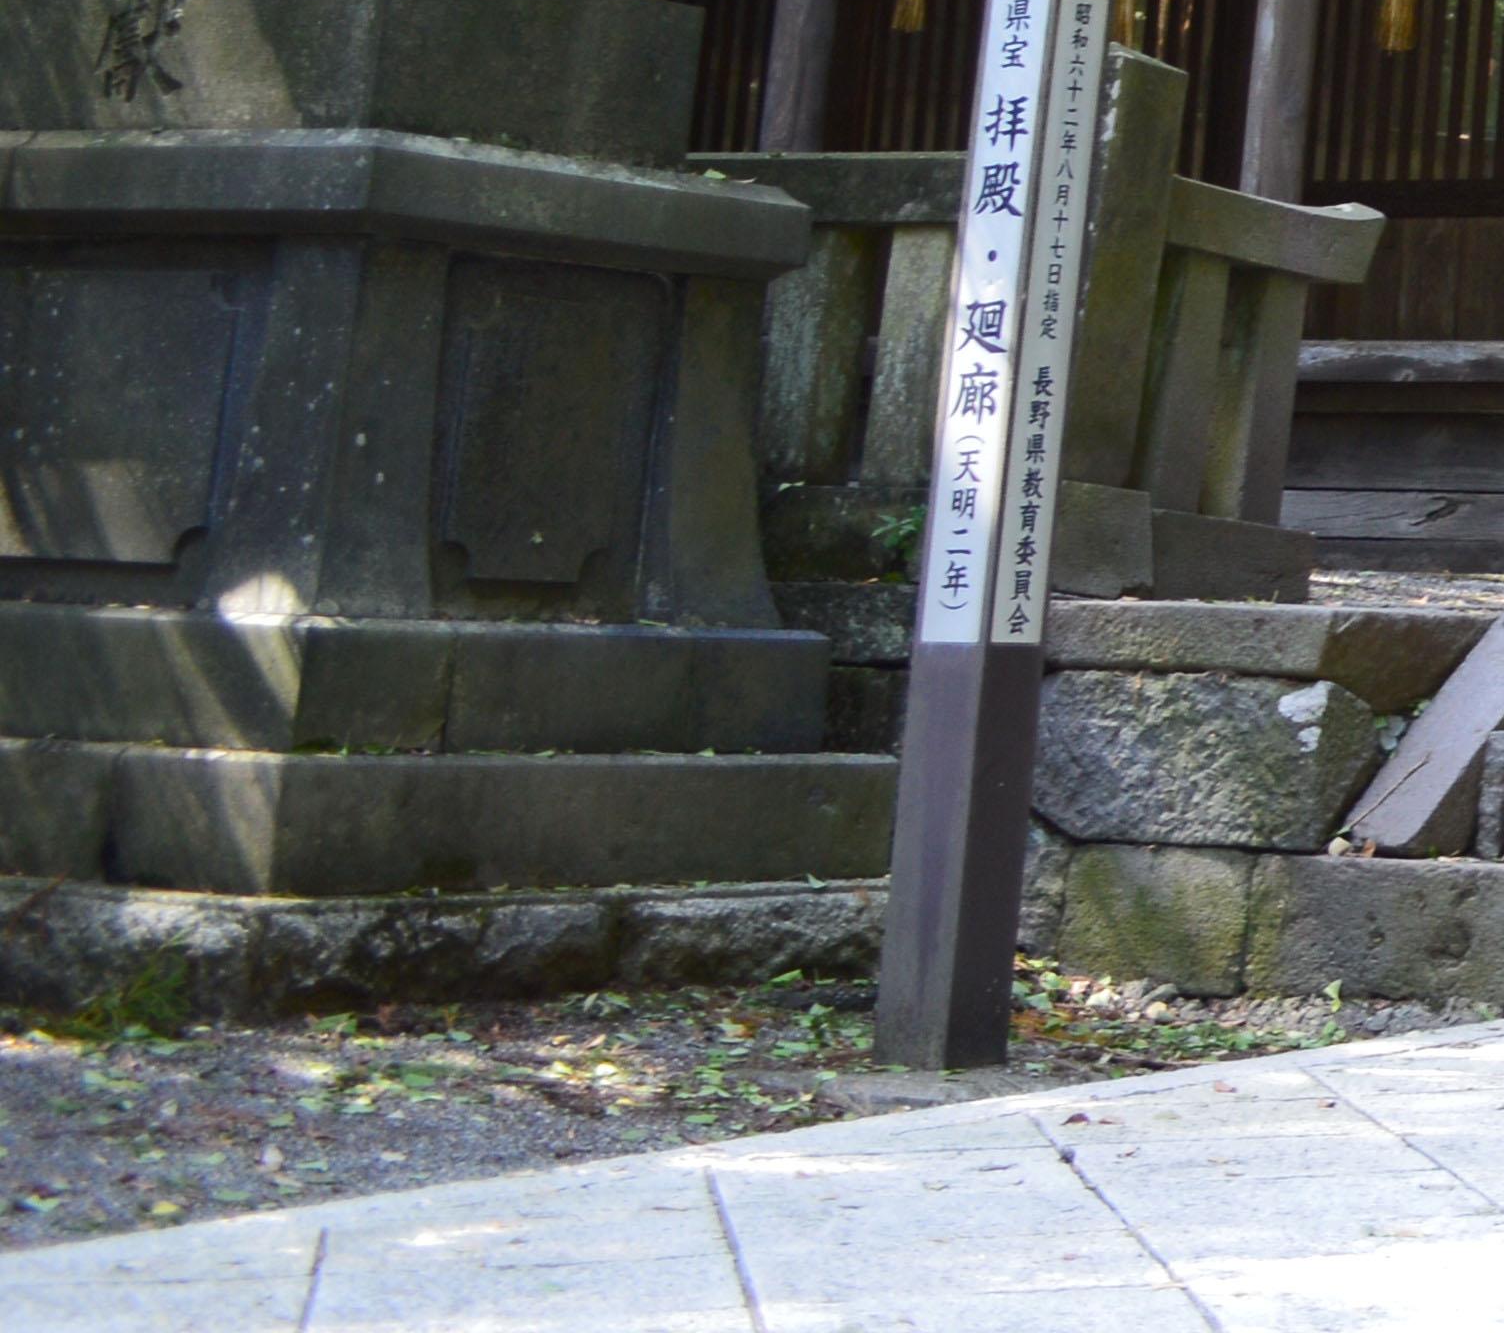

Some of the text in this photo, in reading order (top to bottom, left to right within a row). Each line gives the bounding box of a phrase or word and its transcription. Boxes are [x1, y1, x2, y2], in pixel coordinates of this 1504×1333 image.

[1006, 2, 1093, 635] 昭和六十二年八月十七日指定 長野県教育委員会
